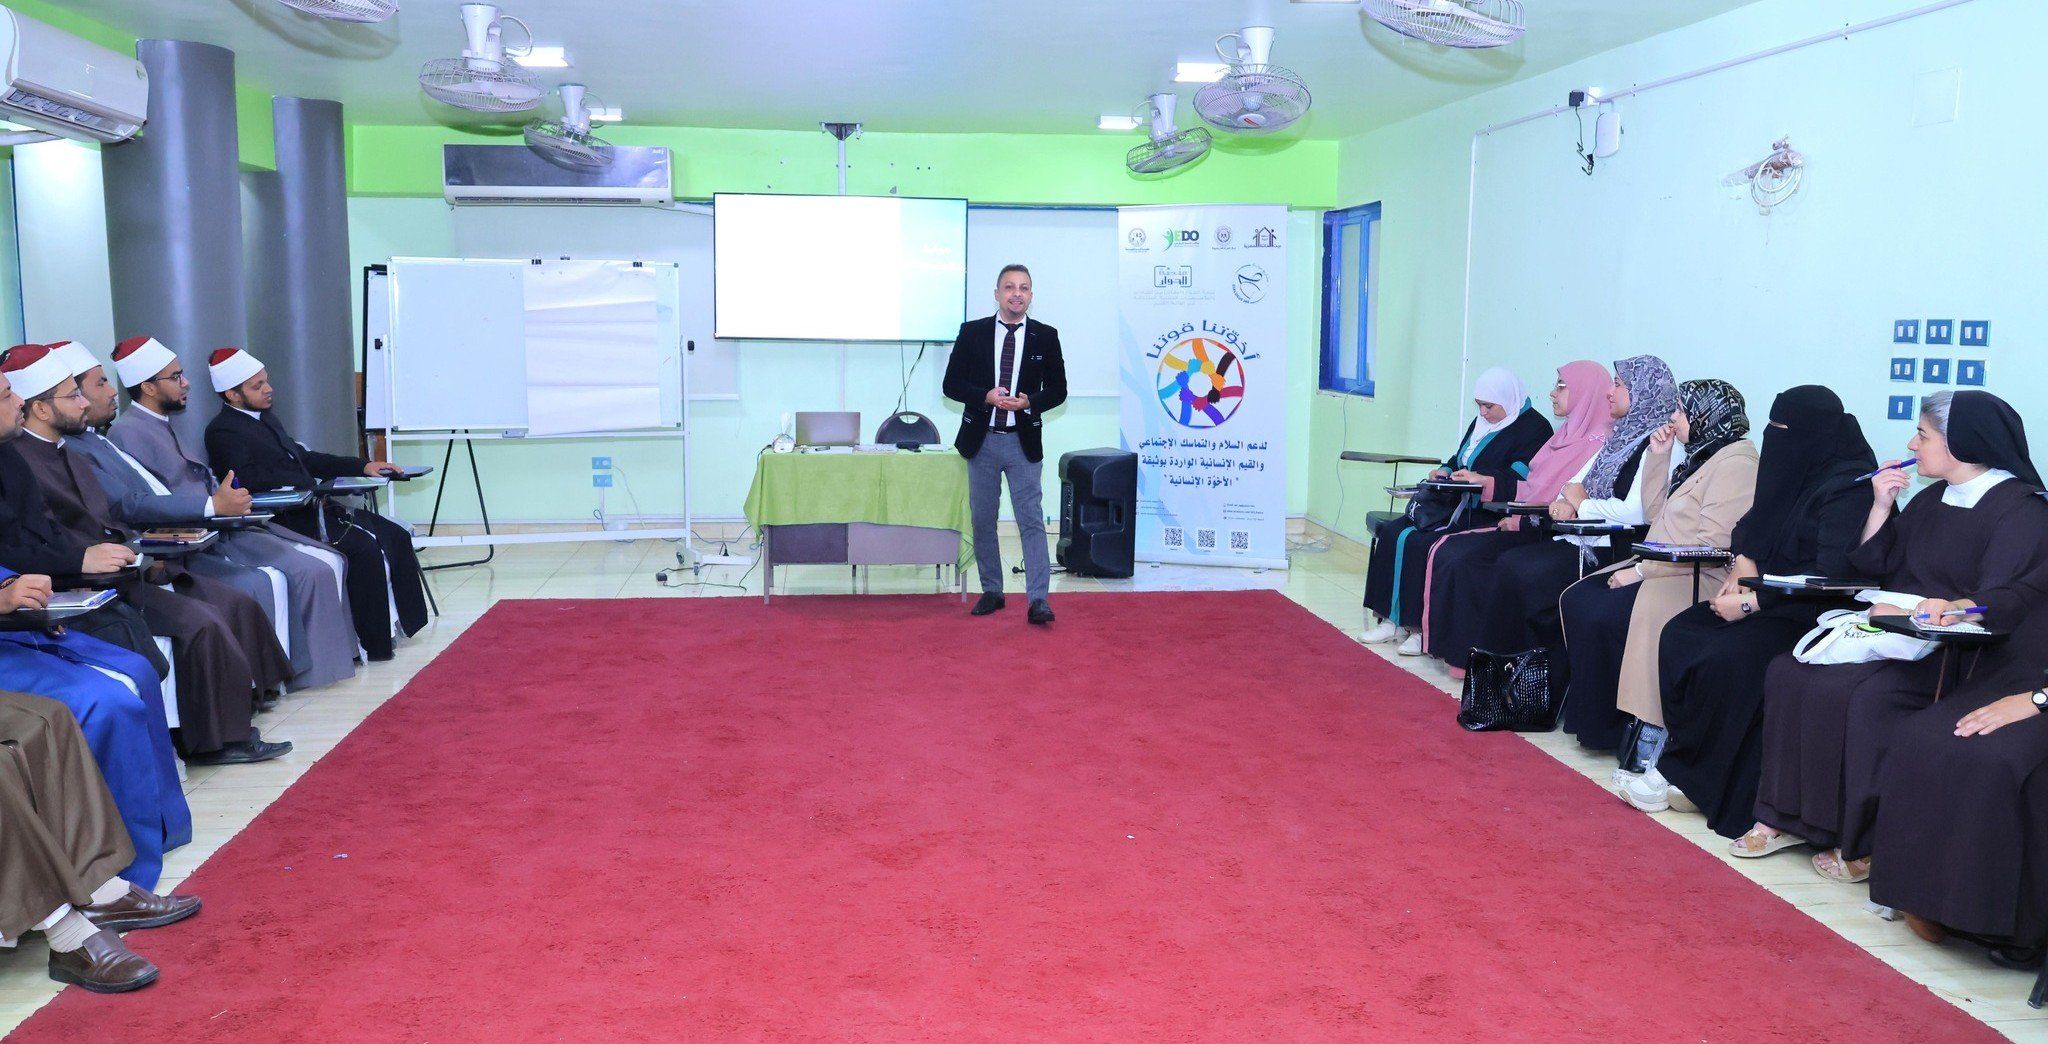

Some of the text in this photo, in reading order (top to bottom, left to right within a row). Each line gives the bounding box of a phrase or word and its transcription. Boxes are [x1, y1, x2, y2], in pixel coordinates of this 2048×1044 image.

[1174, 230, 1200, 242] EDO
[1146, 322, 1195, 359] قوتنا
[1180, 438, 1216, 451] والتماسك
[1218, 439, 1243, 451] السلام
[1246, 440, 1267, 451] لدعم
[1141, 454, 1264, 472] والقيم الإنسانية الواردة بوثيقة
